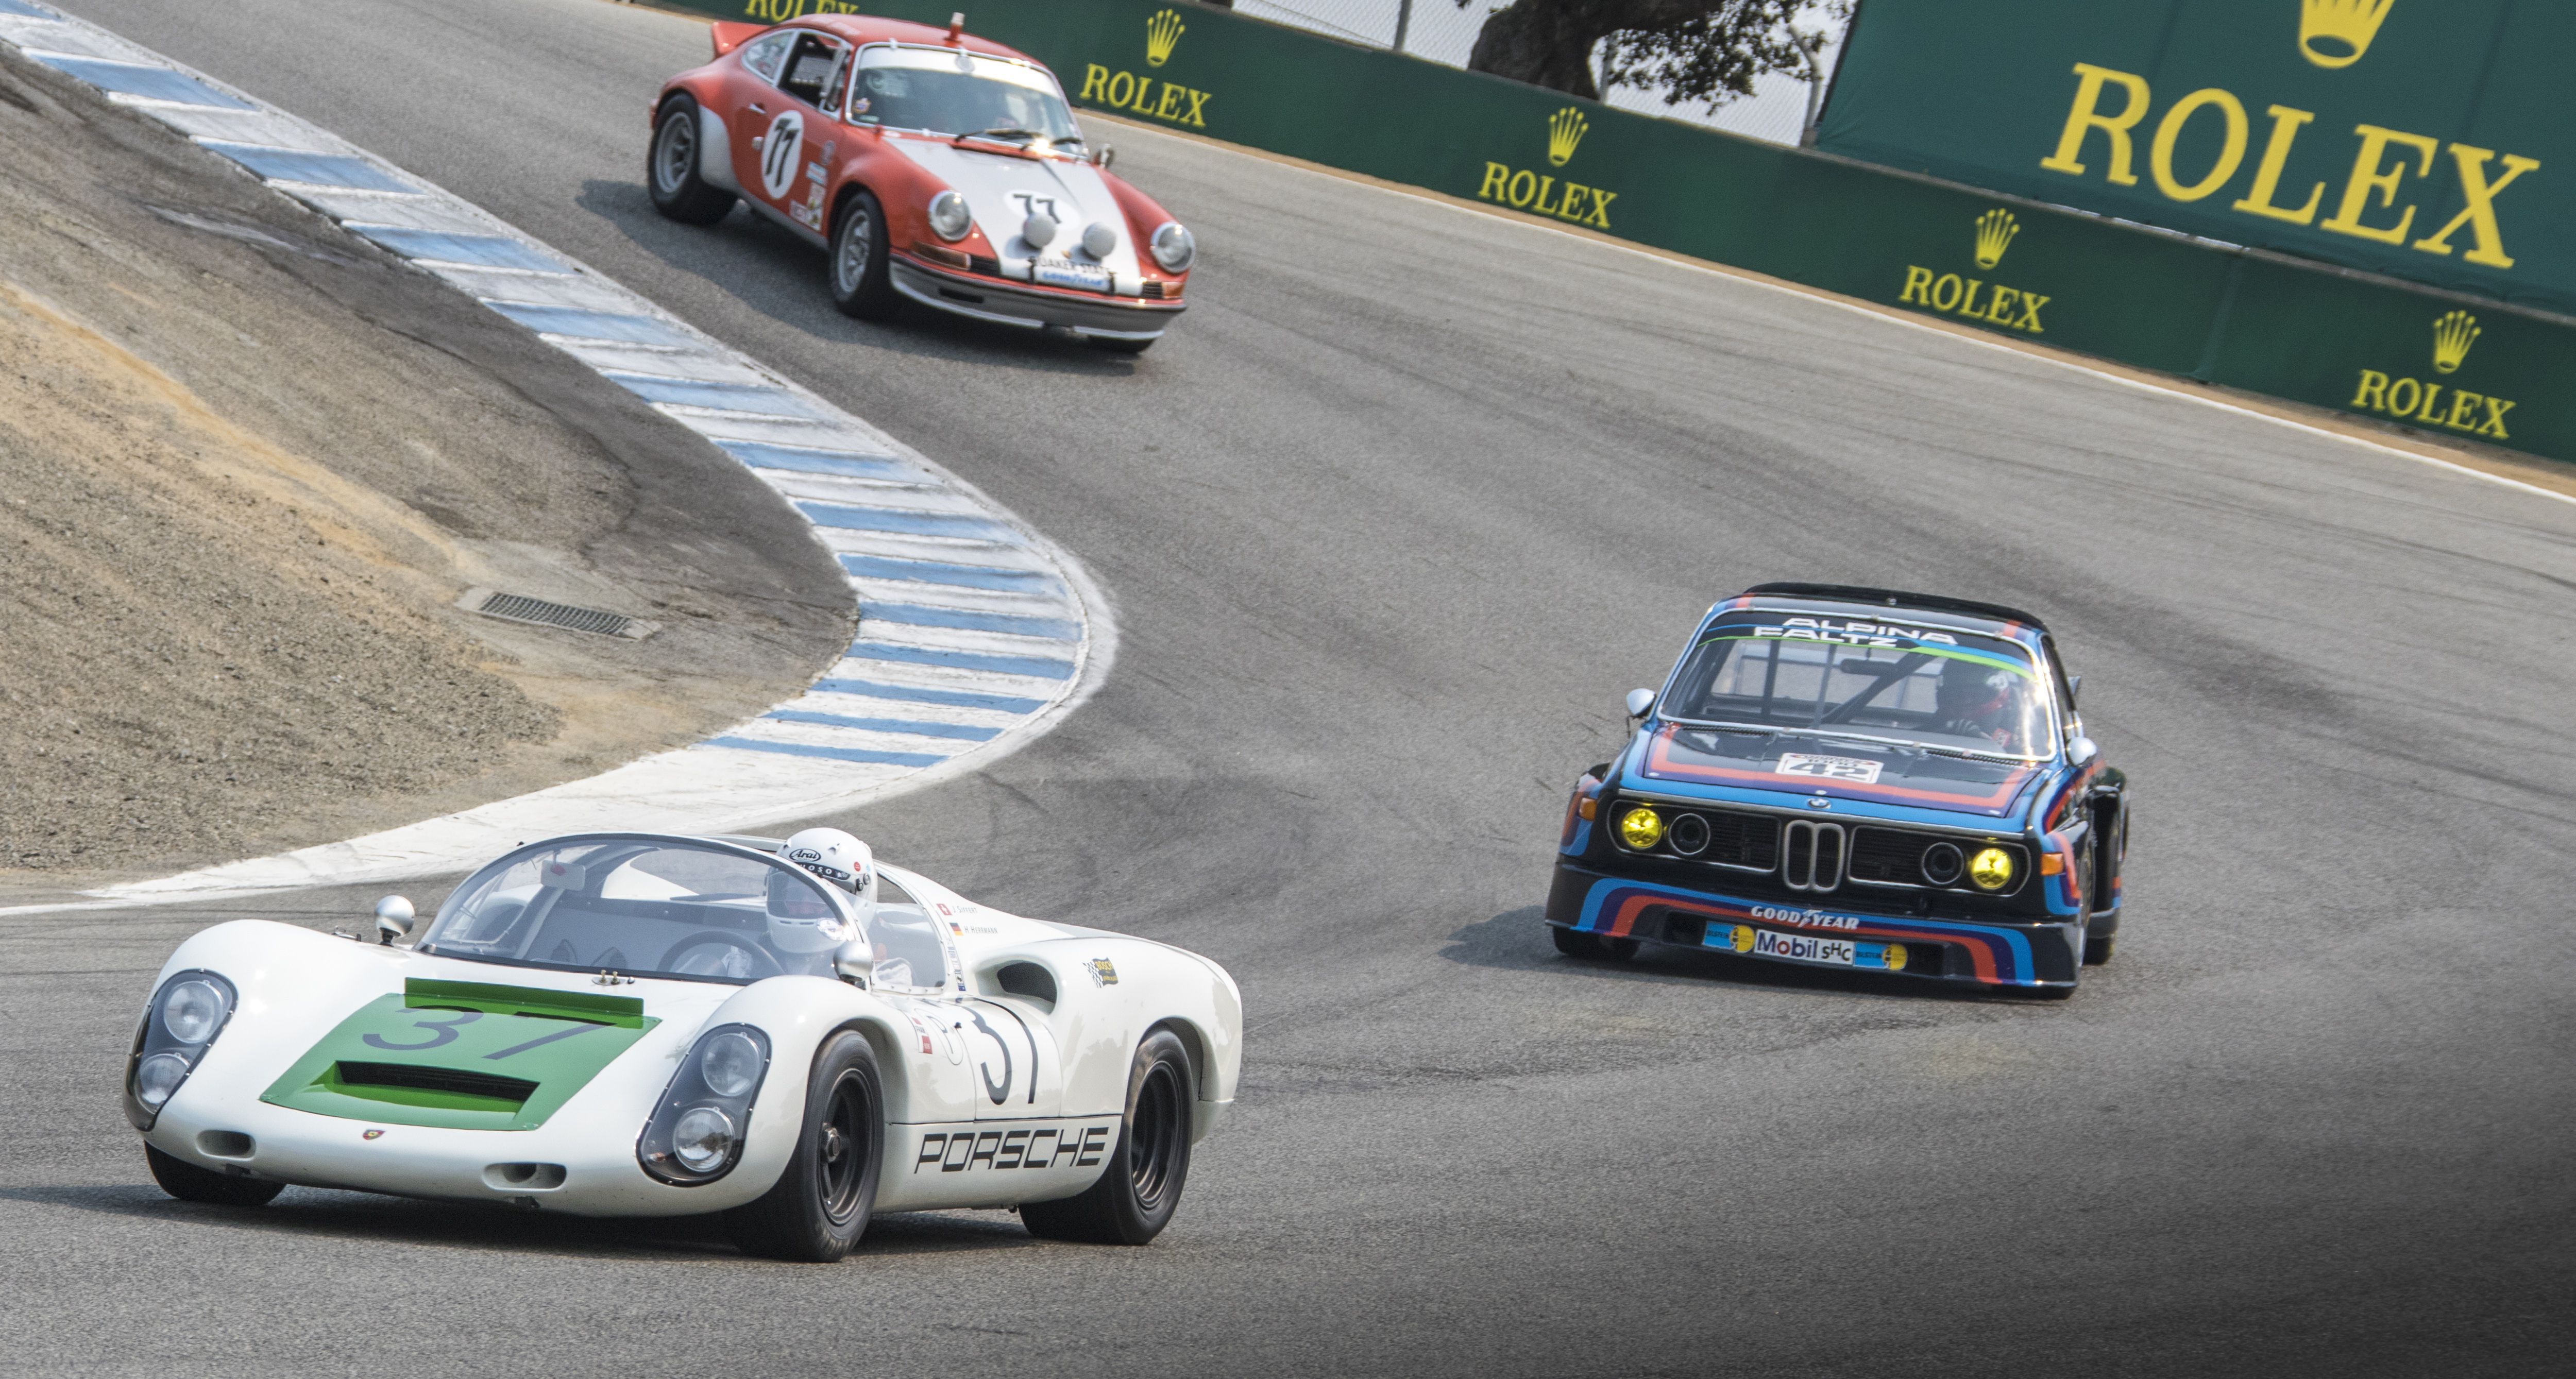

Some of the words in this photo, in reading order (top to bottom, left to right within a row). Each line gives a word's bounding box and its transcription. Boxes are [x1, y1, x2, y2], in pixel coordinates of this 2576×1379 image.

[1079, 63, 1211, 128] ROLEX
[766, 118, 799, 188] 77
[2040, 62, 2540, 268] ROLEX
[1013, 193, 1061, 224] 77
[1478, 161, 1617, 229] ROLEX
[1899, 265, 2050, 333] ROLEX
[2351, 369, 2516, 439] ROLEX
[1754, 626, 1899, 648] FALTZ
[1783, 617, 1958, 645] ALPINA
[1789, 762, 1870, 781] 42
[794, 849, 818, 859] Arai
[1757, 931, 1818, 959] Mobil
[362, 1005, 618, 1060] 37
[913, 1127, 1109, 1174] PORSCHE
